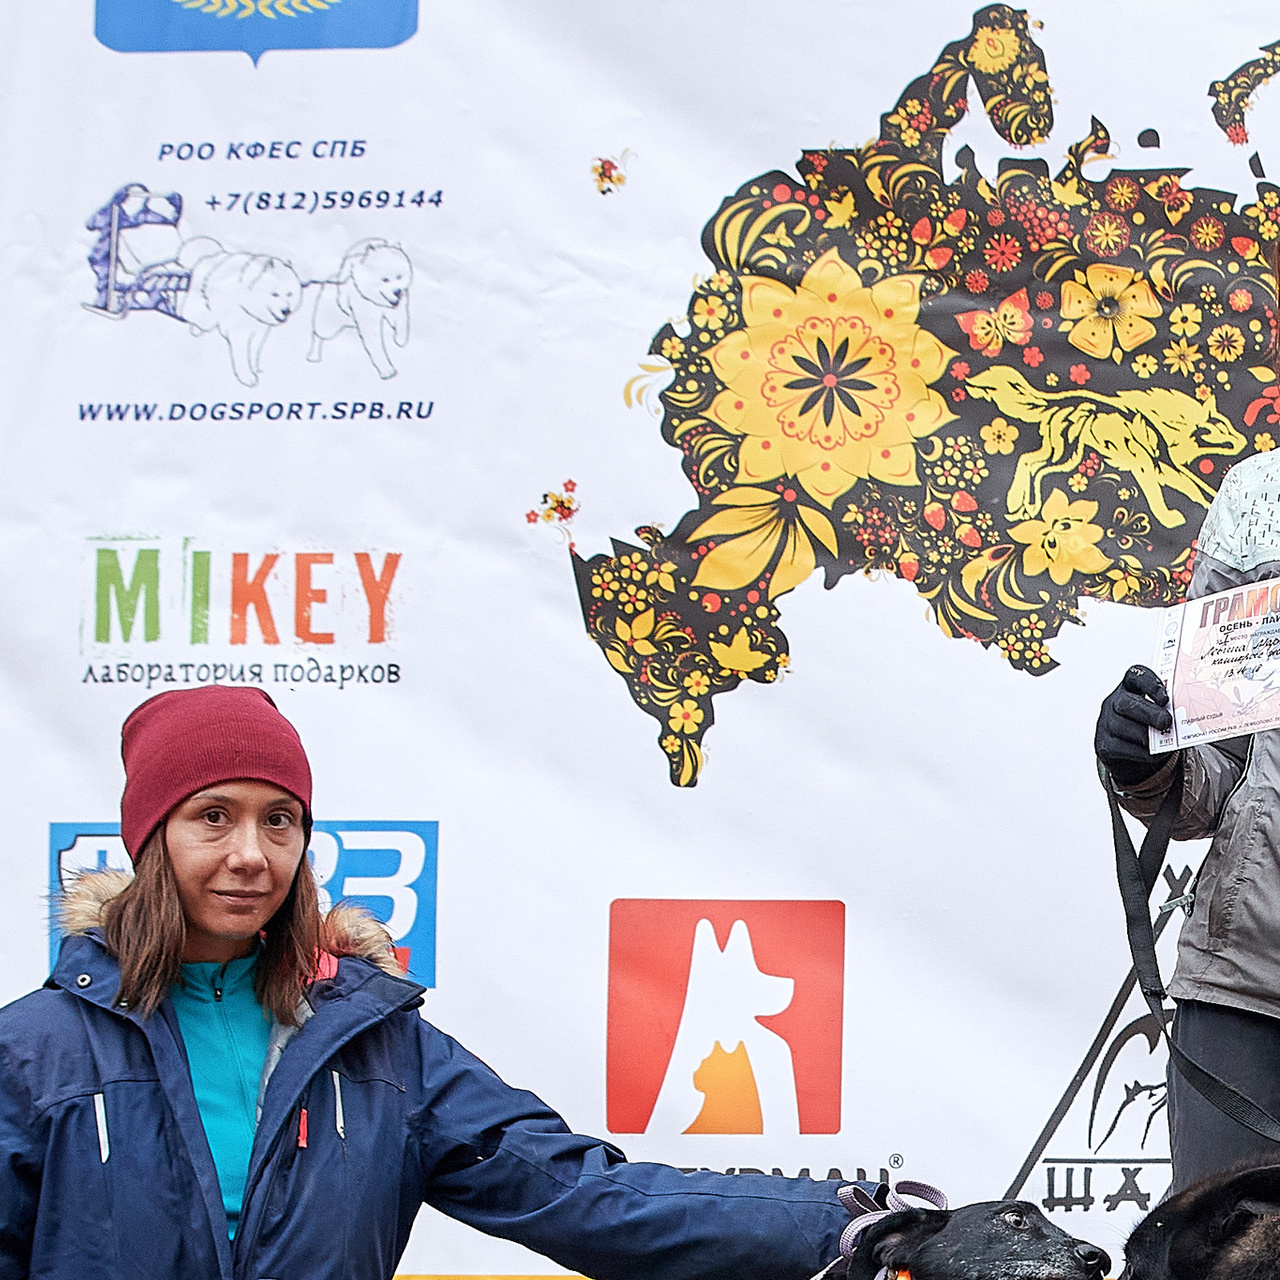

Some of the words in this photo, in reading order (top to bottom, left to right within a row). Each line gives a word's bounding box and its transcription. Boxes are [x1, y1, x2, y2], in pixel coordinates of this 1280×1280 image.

[157, 142, 215, 161] РОО
[226, 140, 301, 161] КФЕС
[311, 140, 367, 160] СПБ
[204, 189, 445, 214] +7(812)5969144
[78, 400, 435, 422] WWW.DOGSPORT.SPB.RU
[92, 547, 404, 647] MIKEY
[1219, 621, 1253, 633] ОСЕНЬ
[81, 658, 264, 690] лаборатория
[272, 656, 402, 690] подарков
